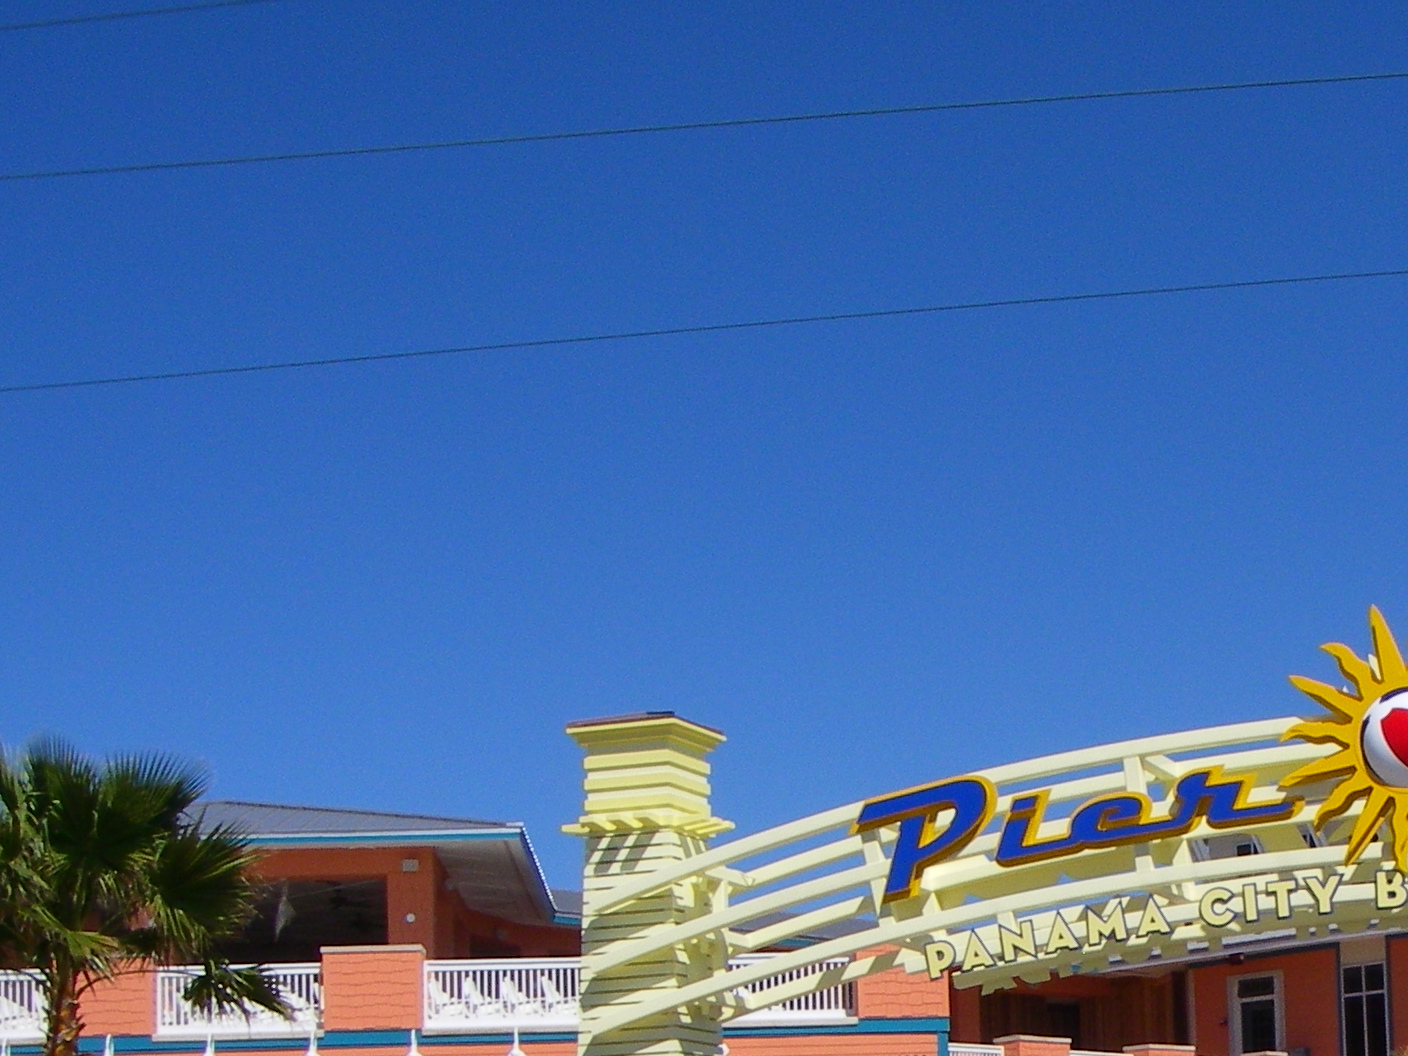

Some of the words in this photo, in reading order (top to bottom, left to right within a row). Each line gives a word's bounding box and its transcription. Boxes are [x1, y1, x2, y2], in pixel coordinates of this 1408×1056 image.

[850, 775, 1304, 903] Pier
[925, 893, 1171, 980] PANAMA
[1198, 871, 1345, 927] CITY
